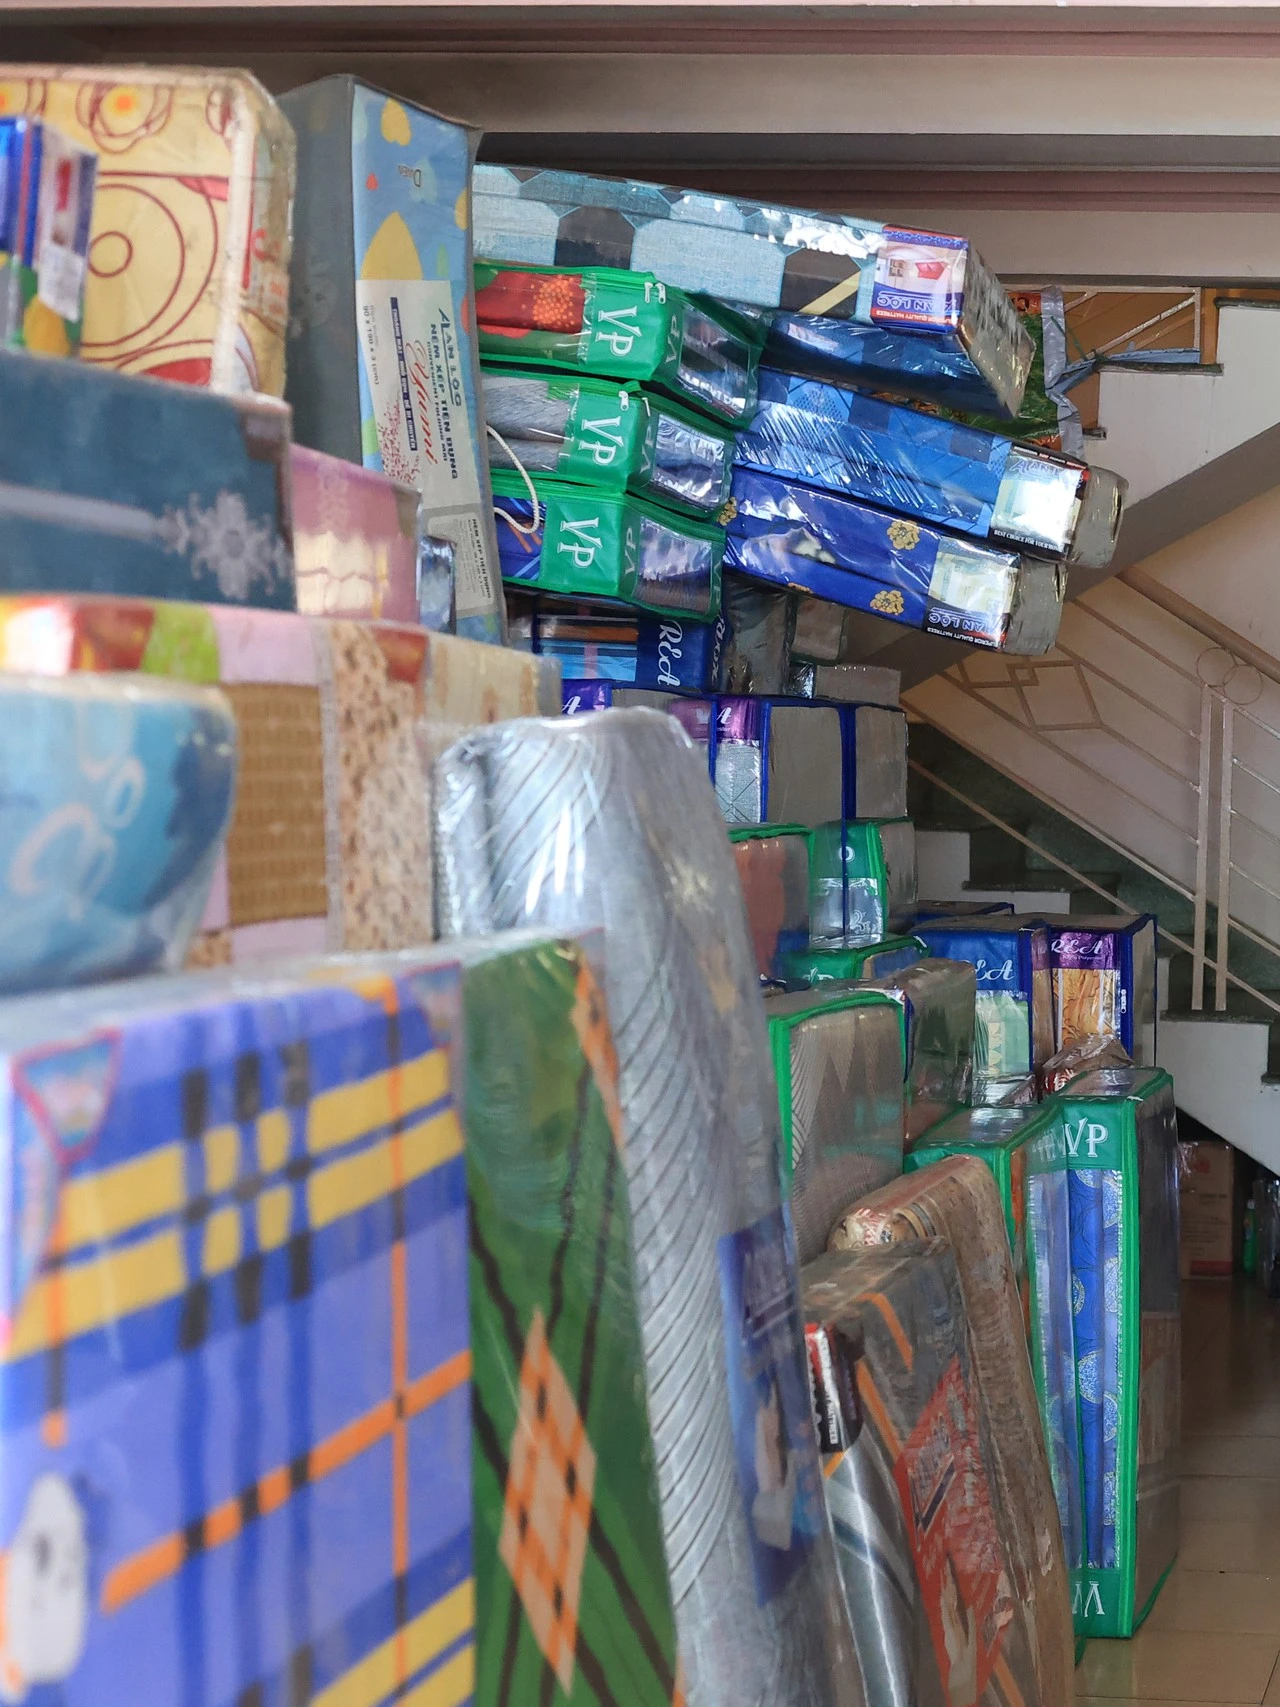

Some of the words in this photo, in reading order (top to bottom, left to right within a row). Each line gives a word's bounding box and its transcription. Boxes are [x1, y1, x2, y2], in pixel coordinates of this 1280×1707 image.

[594, 306, 642, 357] VP
[578, 415, 624, 465] VP
[559, 518, 602, 569] VP
[657, 620, 683, 686] REA
[953, 632, 973, 641] QUALITY
[1051, 938, 1103, 954] REA
[974, 959, 1015, 980] EA
[1064, 1116, 1108, 1157] VP
[1084, 1580, 1105, 1617] V
